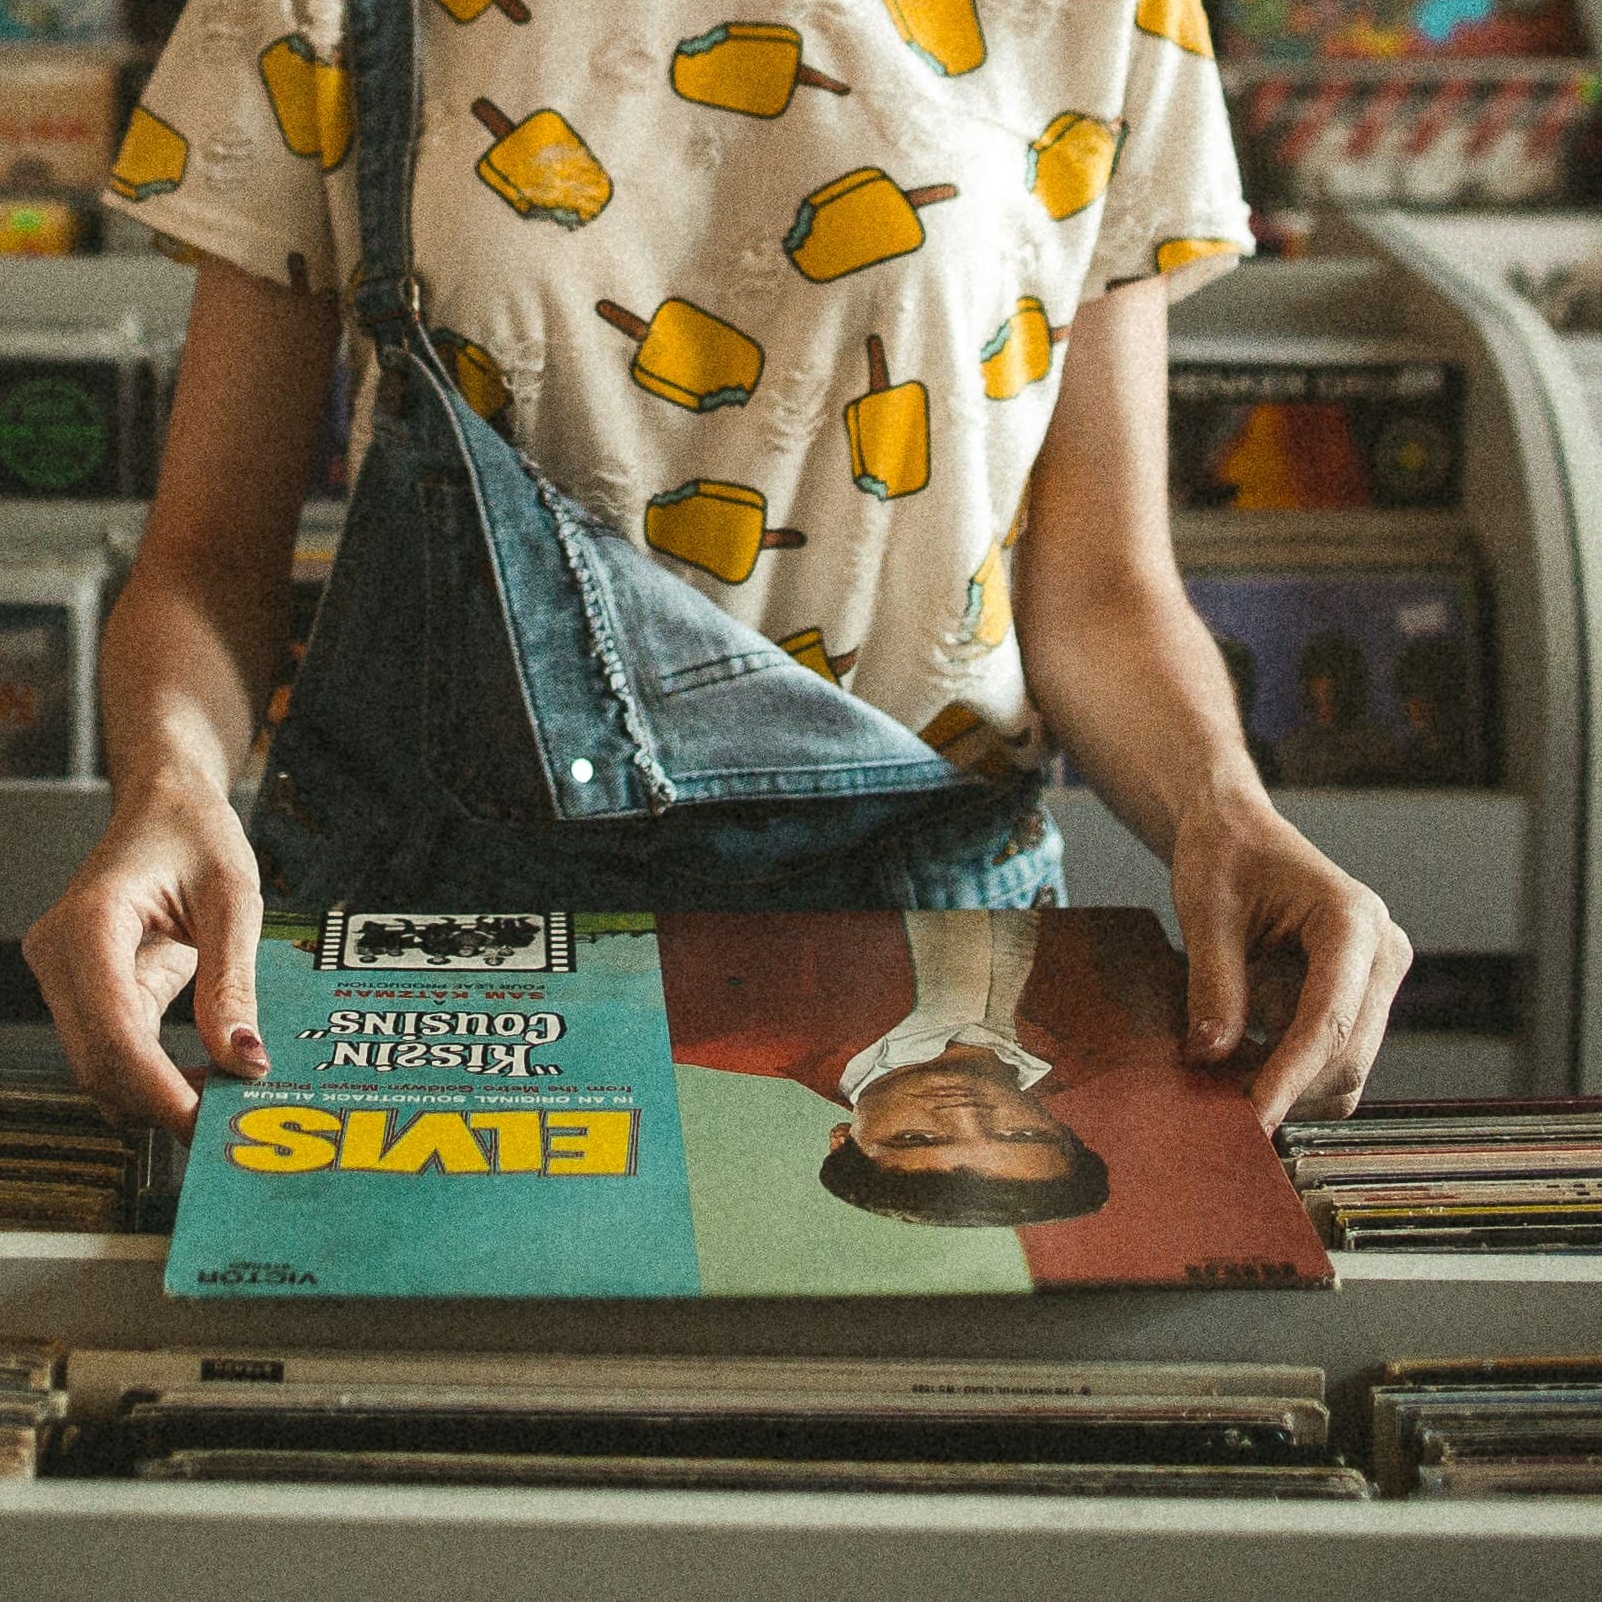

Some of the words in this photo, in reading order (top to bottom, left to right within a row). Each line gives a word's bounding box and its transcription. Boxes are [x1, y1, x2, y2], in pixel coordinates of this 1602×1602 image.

[336, 981, 448, 990] PRODUCTION
[499, 982, 546, 991] FOUR
[333, 989, 469, 1000] KATZMAN
[484, 990, 545, 1000] SAM
[548, 1084, 578, 1094] the
[586, 1084, 633, 1094] from
[242, 1090, 315, 1102] ALBUM
[322, 1092, 466, 1103] SOUNDTRACK
[474, 1094, 571, 1104] ORIGINAL
[578, 1095, 605, 1104] AN
[613, 1095, 634, 1104] IN
[226, 1106, 641, 1176] ELVIS
[197, 1271, 317, 1285] VICTOR
